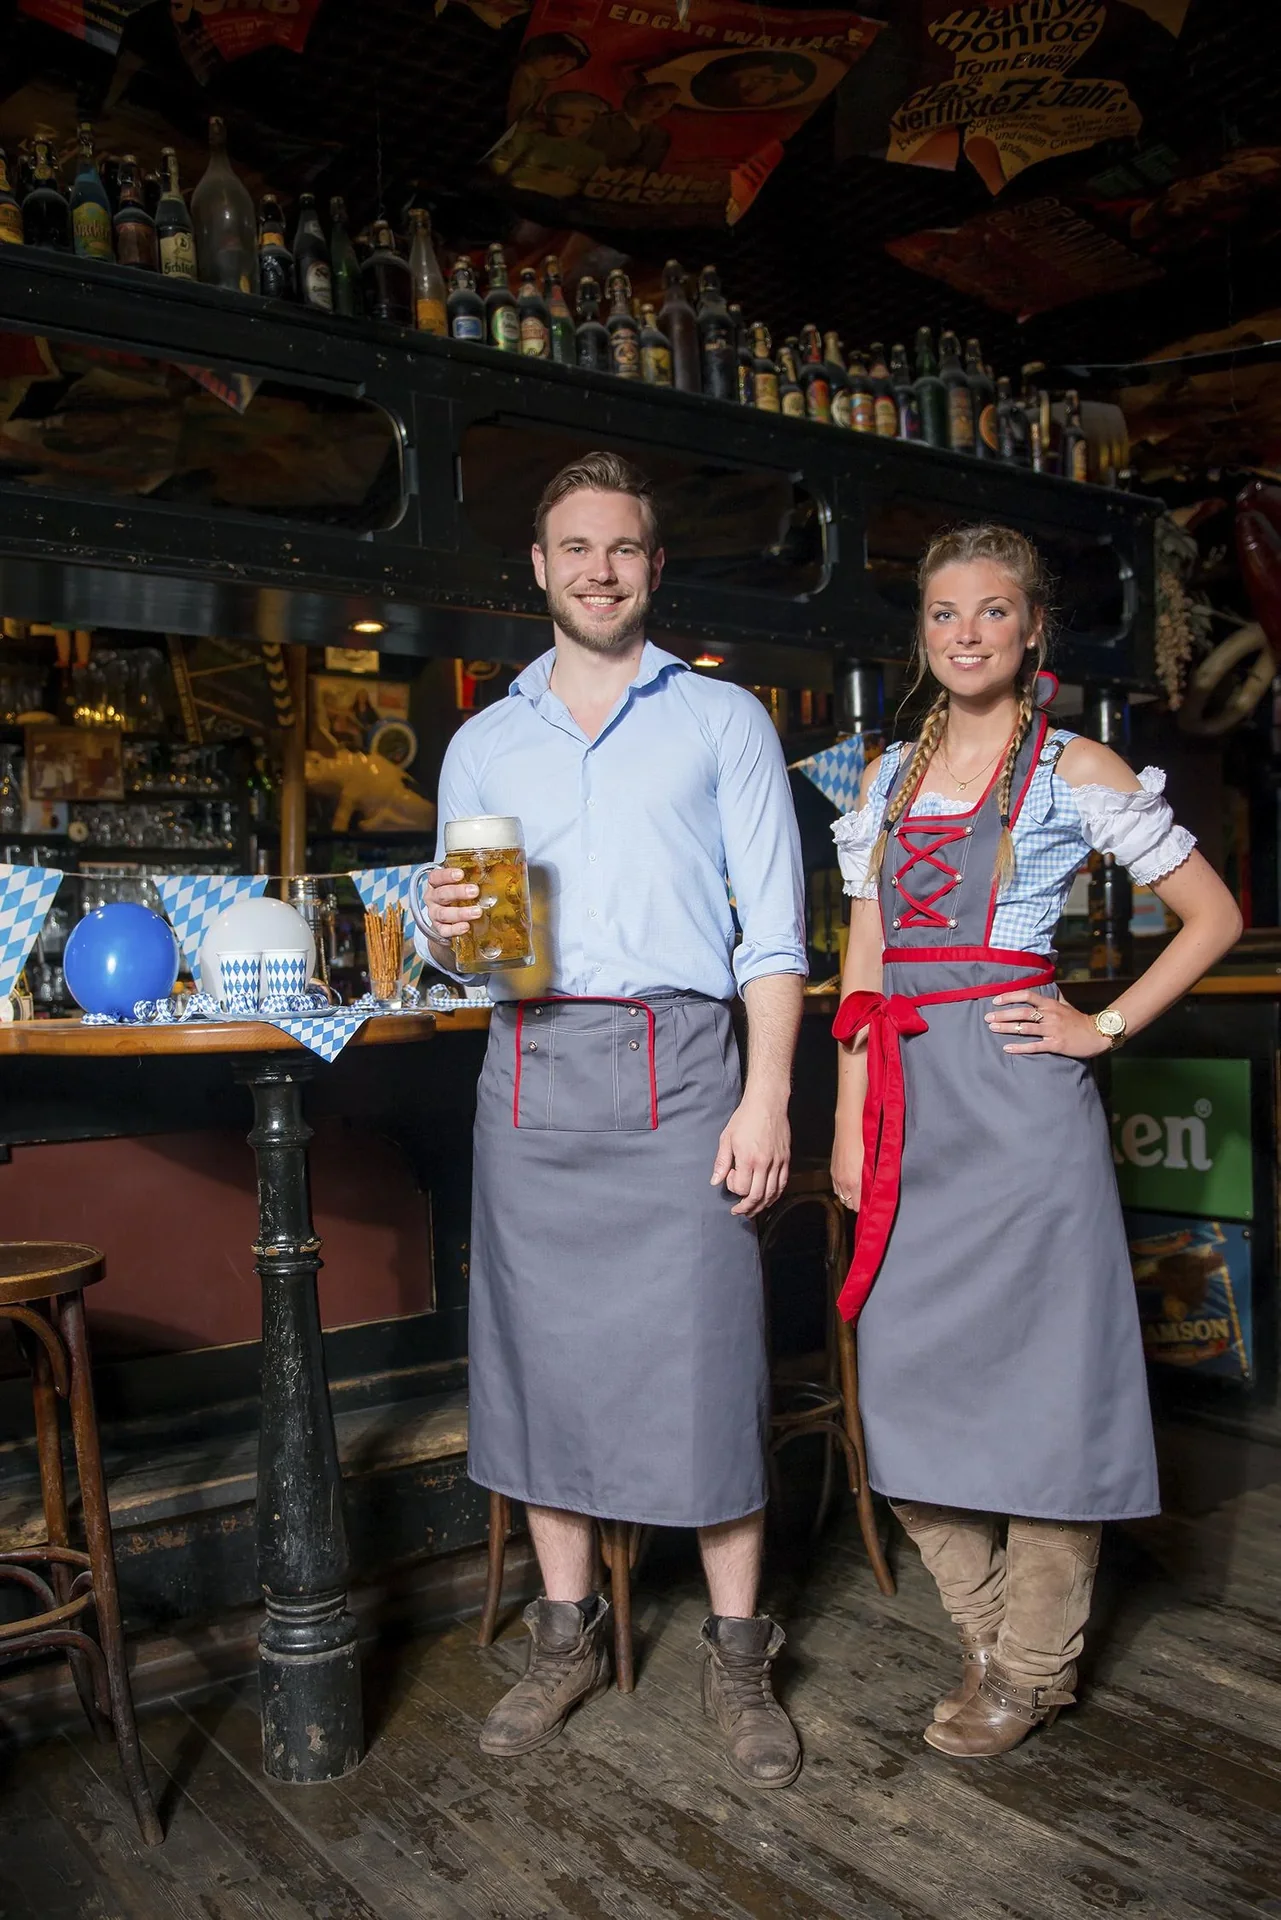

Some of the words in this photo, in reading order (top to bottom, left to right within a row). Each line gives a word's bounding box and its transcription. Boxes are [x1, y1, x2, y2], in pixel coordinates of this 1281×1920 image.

[608, 3, 717, 39] EDGAR
[723, 27, 865, 50] WALLACE
[931, 20, 1098, 54] monroe
[955, 58, 1009, 79] Tom
[1010, 51, 1078, 76] Ewell
[890, 93, 1013, 133] verflixte
[903, 83, 978, 111] das
